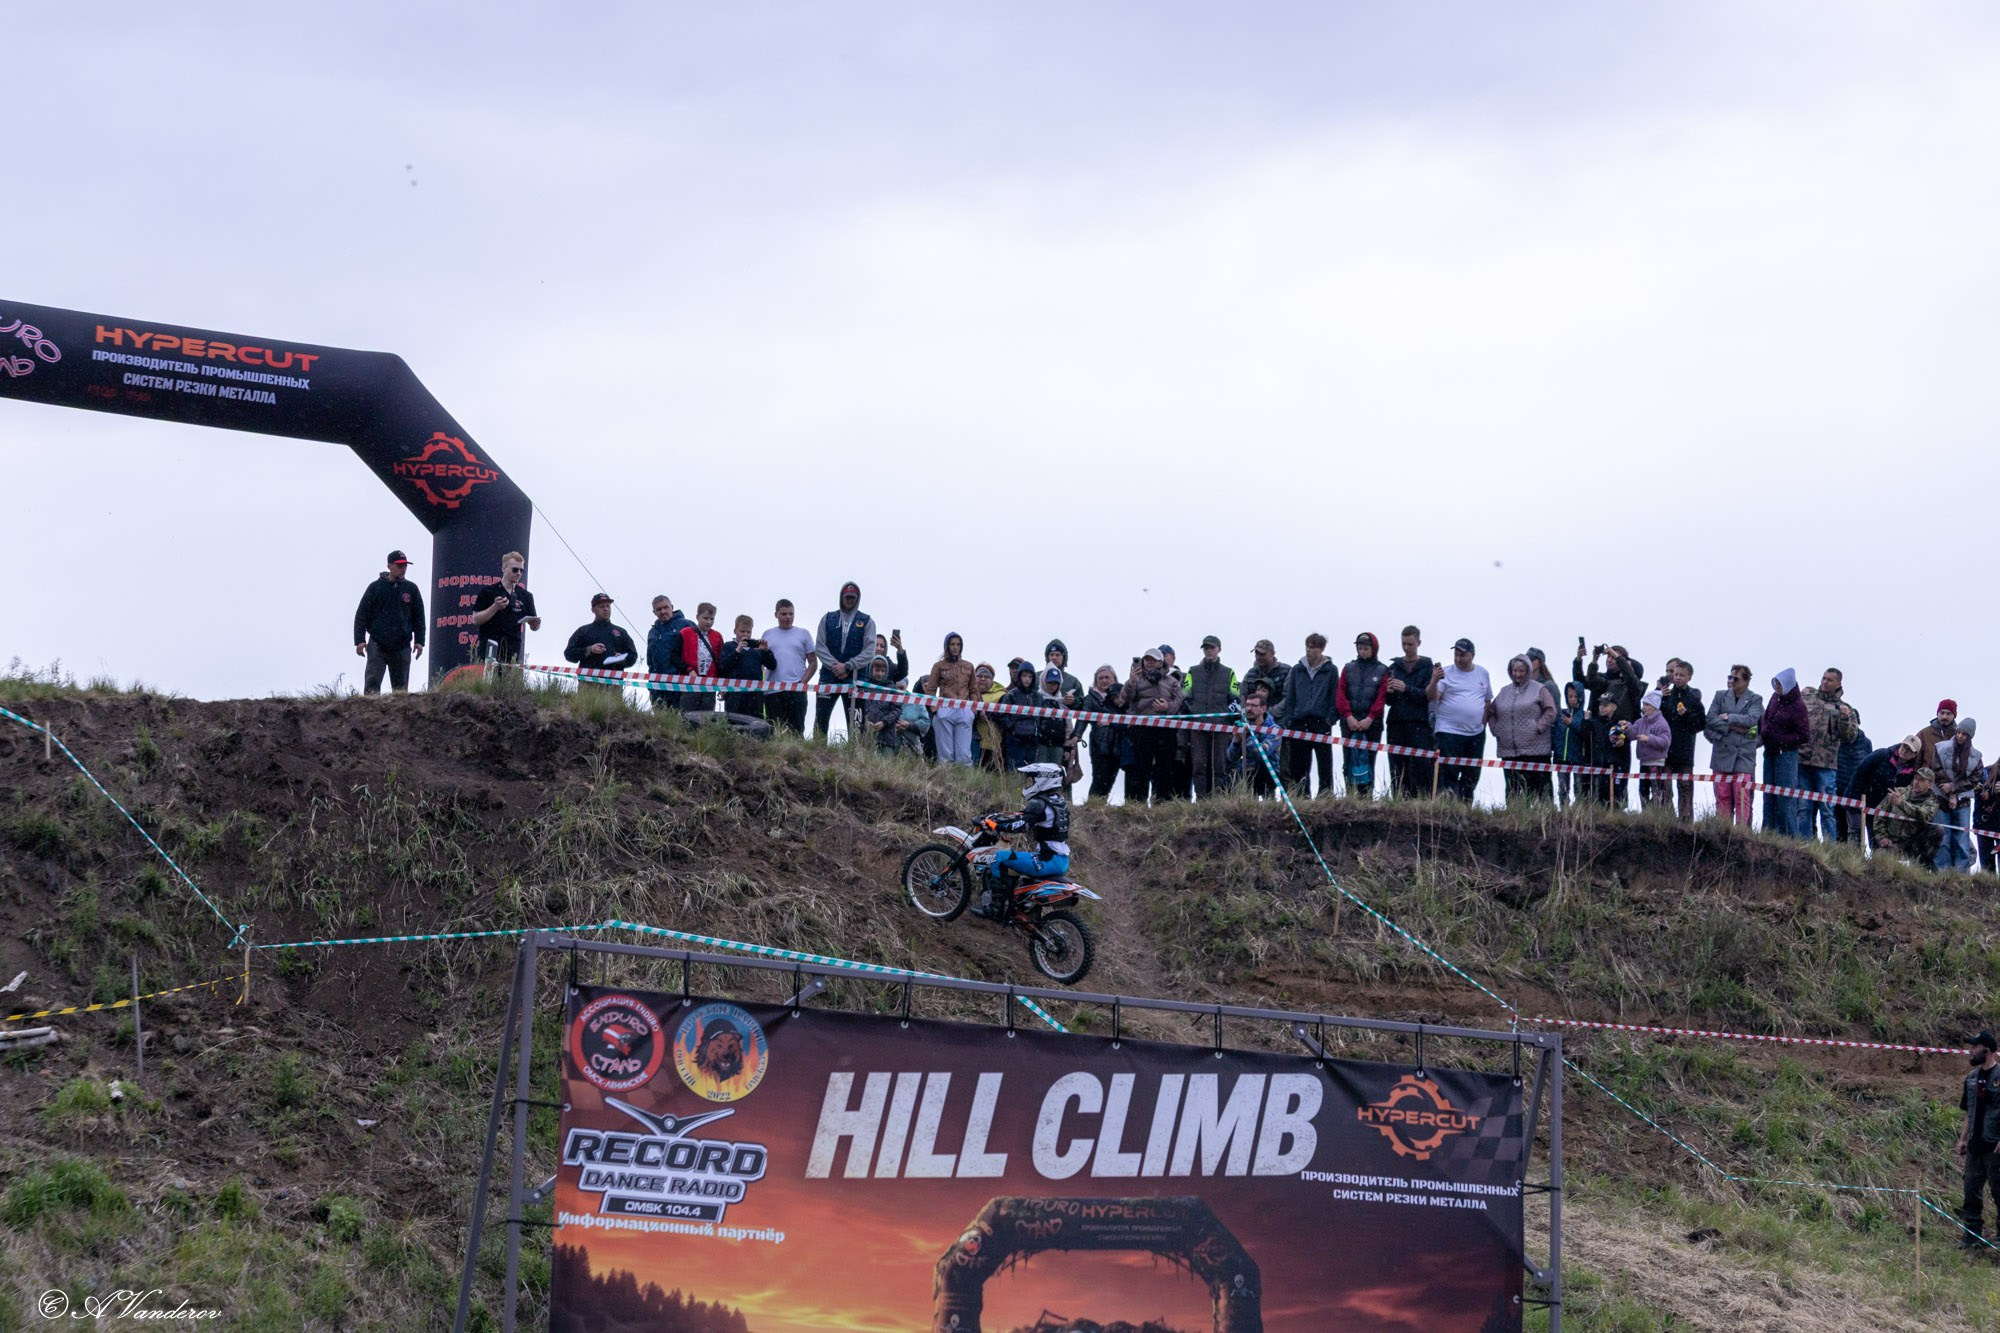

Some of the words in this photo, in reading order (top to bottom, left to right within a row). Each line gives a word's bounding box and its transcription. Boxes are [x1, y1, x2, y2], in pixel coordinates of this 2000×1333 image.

[95, 325, 320, 372] HYPERCUT
[92, 350, 199, 375] ПРОИЗВОДИТЕЛЬ
[201, 365, 310, 390] ПРОМЫШЛЕННЫХ
[123, 372, 174, 391] СИСТЕМ
[176, 379, 217, 395] РЕЗКИ
[218, 383, 277, 405] МЕТАЛЛА
[393, 462, 499, 481] HYPERCUT
[589, 1011, 649, 1036] ENDURO
[706, 1089, 732, 1101] 2022
[805, 1071, 1009, 1179] HILL
[1032, 1070, 1324, 1180] CLIMB
[1357, 1106, 1481, 1131] HYPERCUT
[564, 1131, 767, 1178] RECORD
[584, 1170, 668, 1193] DANCE
[670, 1177, 743, 1200] RADIO
[1301, 1170, 1409, 1189] ПРОИЗВОДИТЕЛЬ
[1411, 1178, 1519, 1197] ПРОМЫШЛЕННЫХ
[624, 1201, 663, 1214] OMSK
[665, 1204, 701, 1216] 104.4
[1333, 1188, 1383, 1202] СИСТЕМ
[1386, 1193, 1427, 1206] РЕЗКИ
[1430, 1196, 1488, 1210] МЕТАЛЛА
[558, 1211, 714, 1237] Информационный
[717, 1226, 785, 1244] партнёр
